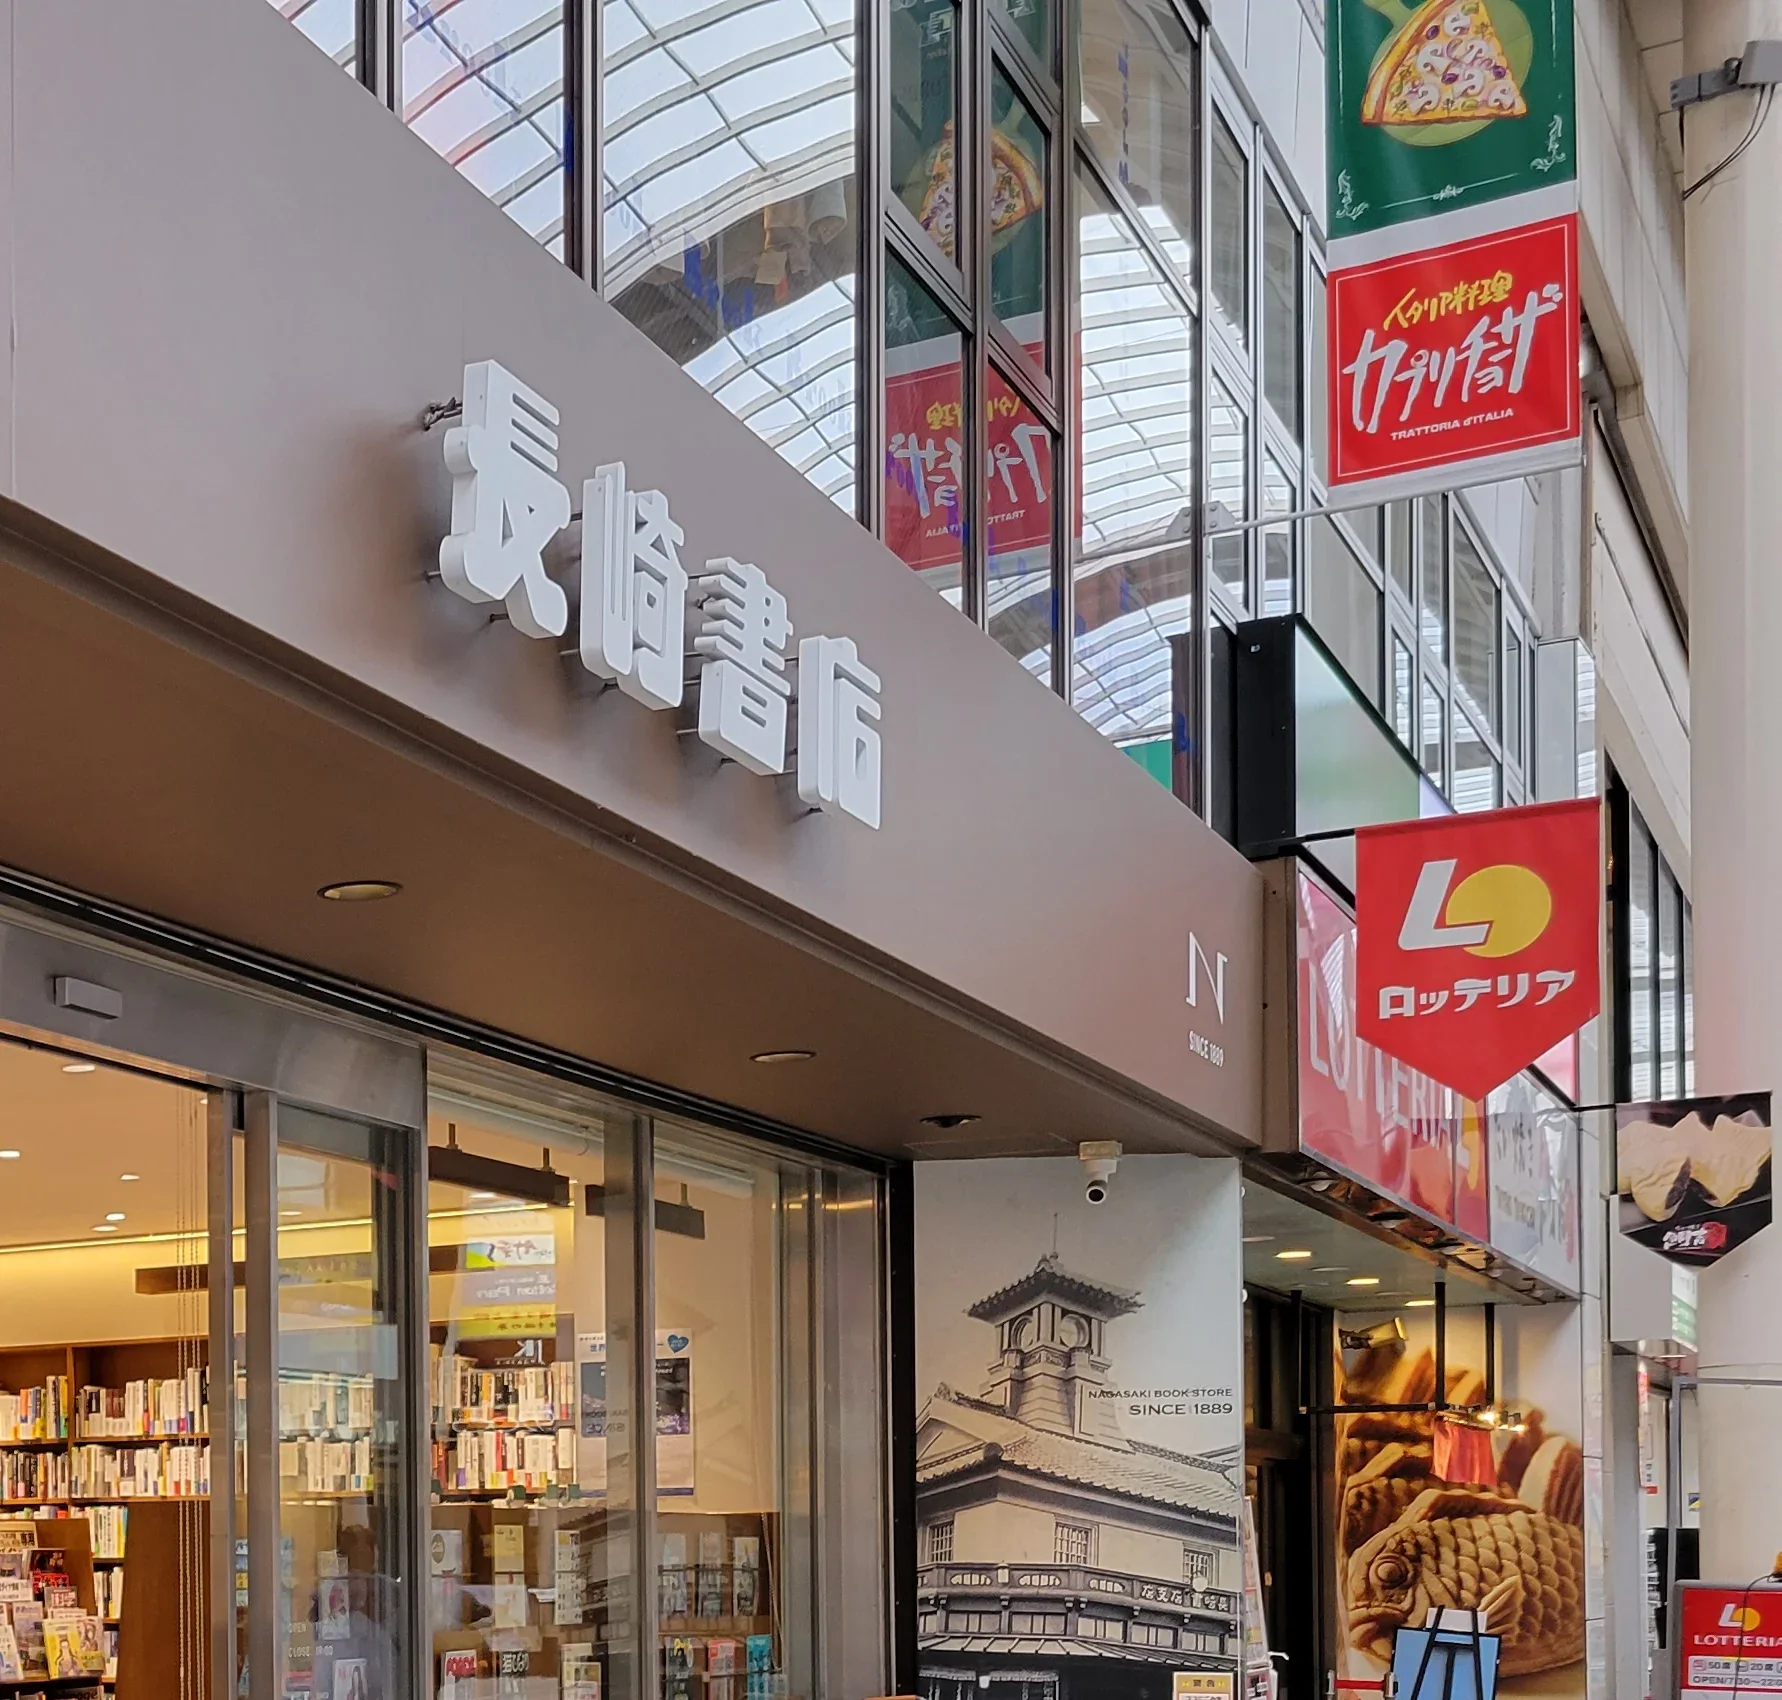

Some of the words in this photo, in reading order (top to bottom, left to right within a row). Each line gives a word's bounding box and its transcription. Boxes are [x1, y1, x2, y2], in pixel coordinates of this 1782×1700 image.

[1383, 269, 1513, 331] イタリア料理
[1341, 283, 1564, 434] カプリチョーザ
[1390, 419, 1460, 441] TRATTORIA
[1463, 407, 1514, 428] d'ITALIA
[439, 359, 882, 831] 長崎書店
[1185, 931, 1228, 1025] N
[1378, 968, 1576, 1020] ロッテリア
[1189, 1030, 1209, 1060] SINCE
[1209, 1042, 1224, 1068] 1889
[1088, 1389, 1151, 1399] NAGASAKI
[1154, 1389, 1189, 1398] BOOK
[1191, 1388, 1233, 1397] STORE
[1129, 1404, 1186, 1416] SINCE
[1194, 1403, 1233, 1415] 1889
